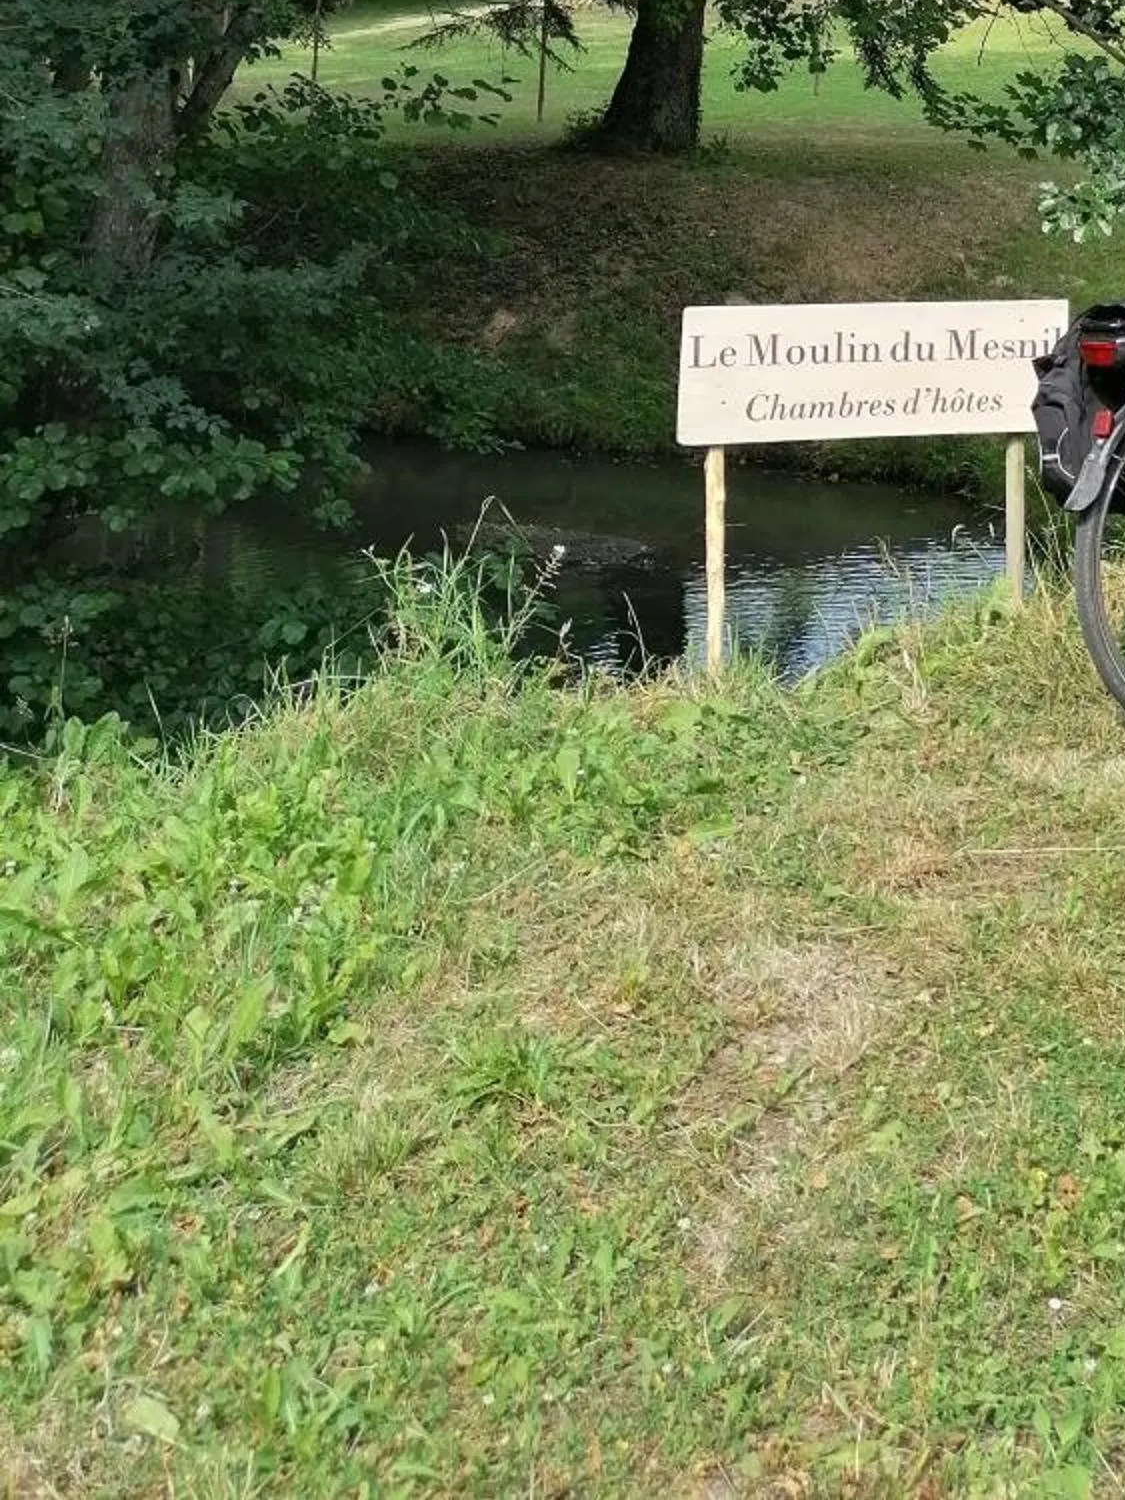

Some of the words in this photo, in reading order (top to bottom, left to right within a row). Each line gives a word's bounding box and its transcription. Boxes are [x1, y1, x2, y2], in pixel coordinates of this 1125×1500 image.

[688, 334, 738, 369] Le
[744, 330, 883, 366] Moulin
[890, 330, 936, 363] du
[745, 392, 896, 421] Chambres
